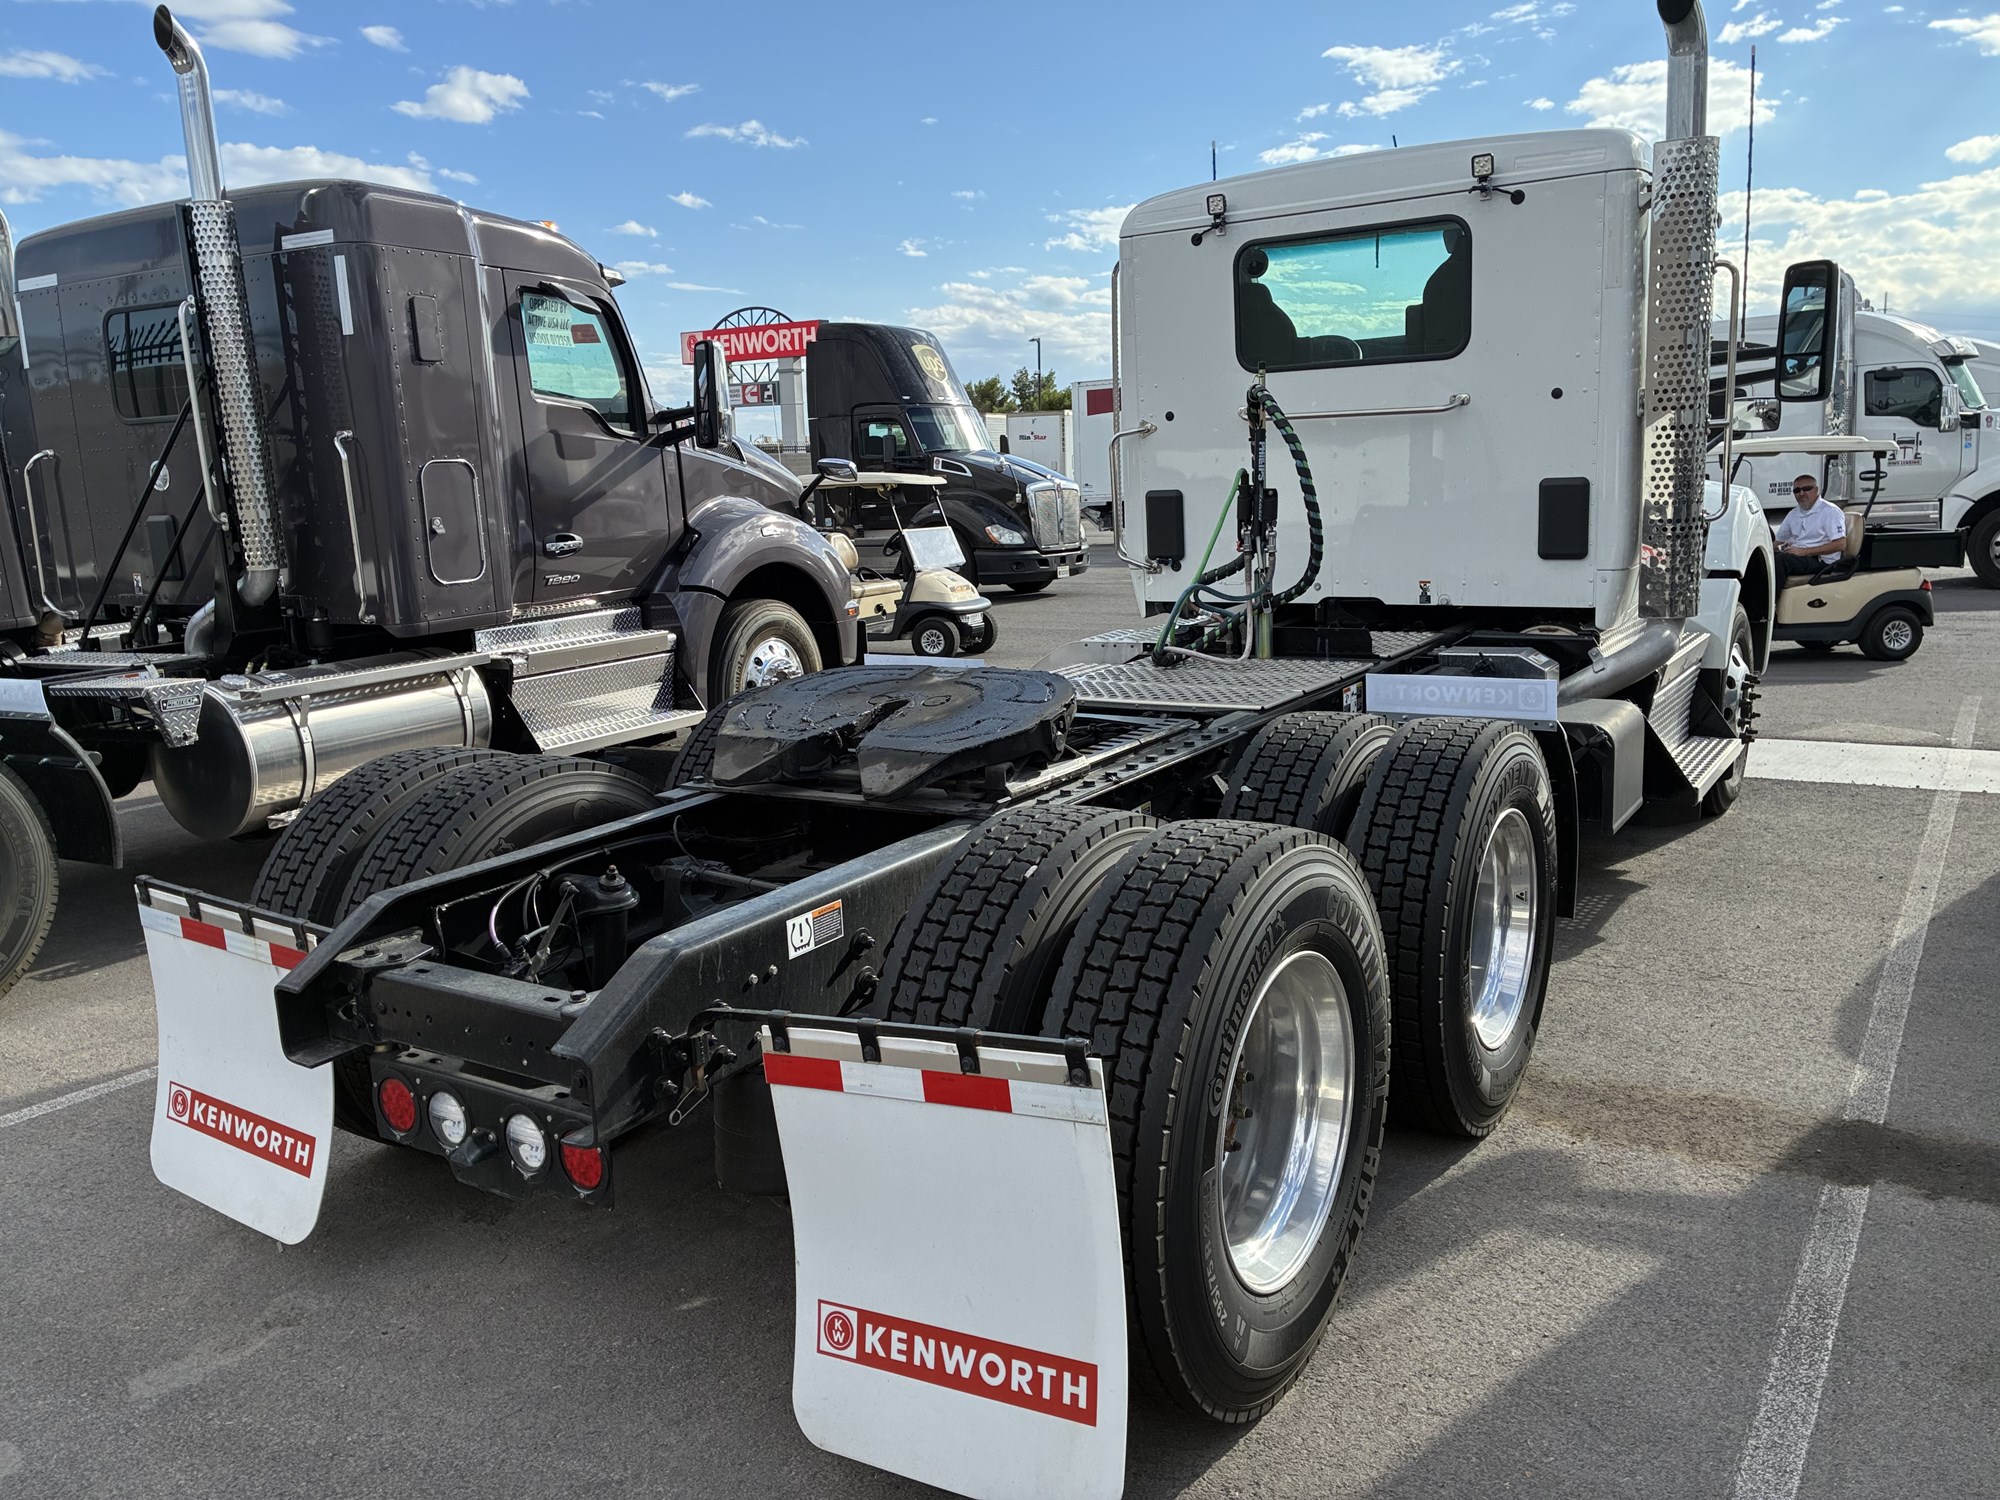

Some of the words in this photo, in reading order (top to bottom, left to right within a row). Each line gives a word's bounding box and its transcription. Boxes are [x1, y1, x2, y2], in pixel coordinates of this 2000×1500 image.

[528, 315, 546, 328] ACTIVE
[548, 317, 558, 329] USA
[560, 319, 570, 330] LLC
[529, 298, 558, 313] OPERATED
[559, 303, 567, 314] BY
[1208, 922, 1278, 1118] Continental
[1326, 885, 1387, 1109] CONTINENTAL
[193, 1099, 310, 1167] KENWORTH
[864, 1323, 1088, 1410] KENWORTH
